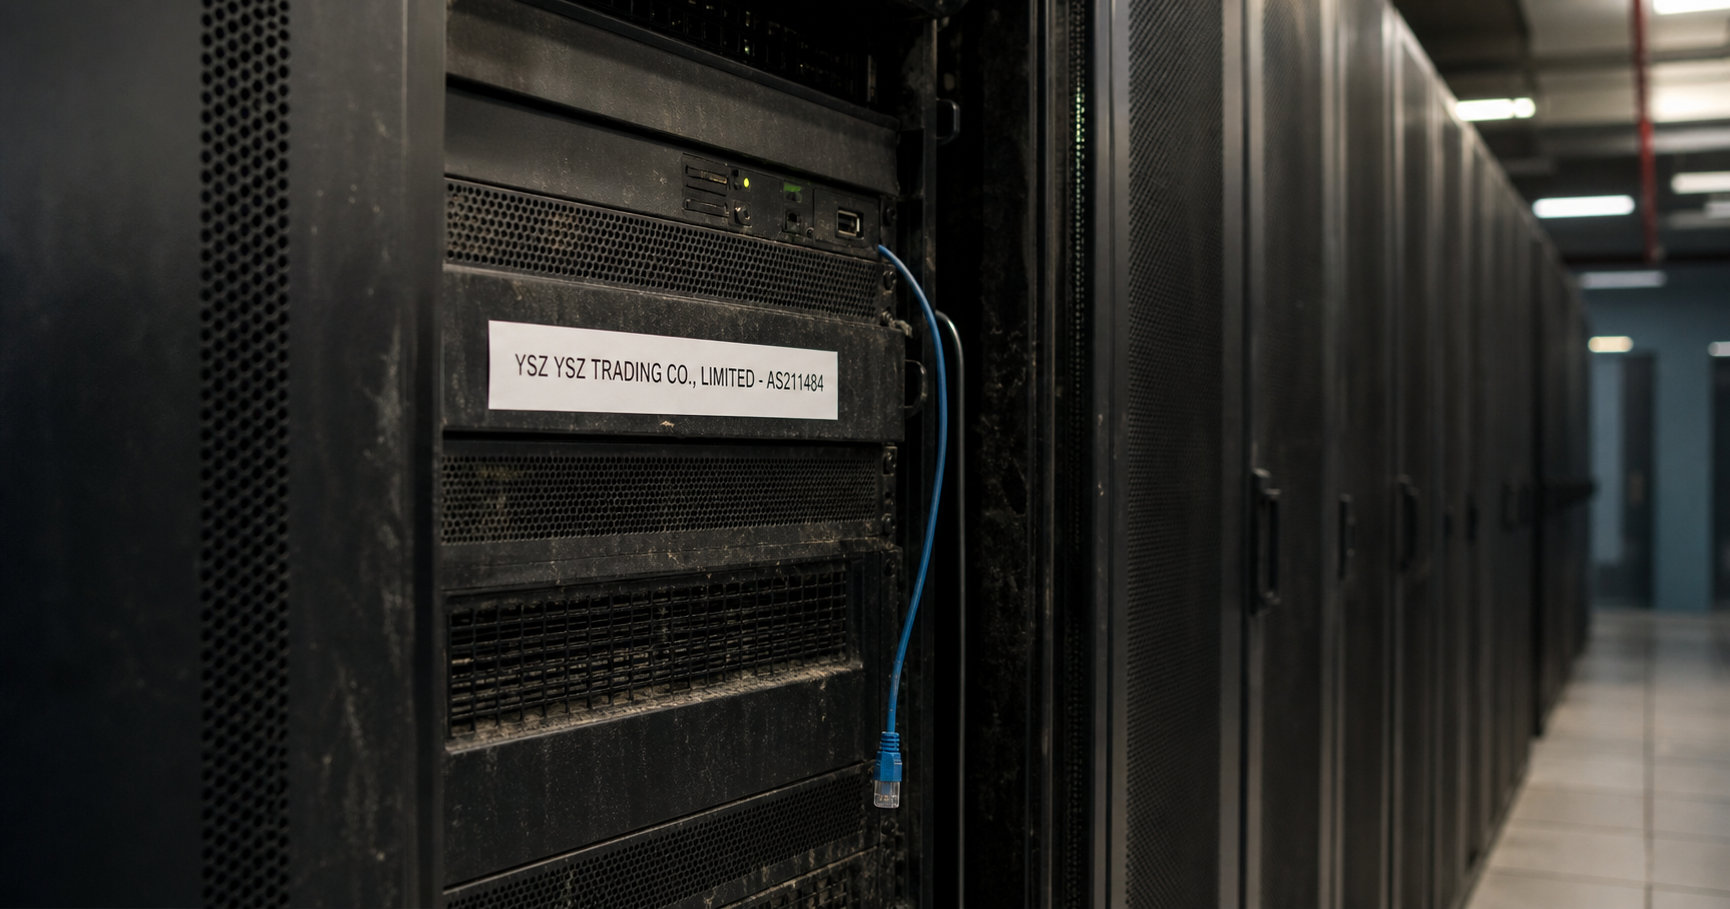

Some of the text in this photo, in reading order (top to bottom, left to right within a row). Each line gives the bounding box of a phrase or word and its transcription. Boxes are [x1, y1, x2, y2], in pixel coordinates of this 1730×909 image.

[515, 353, 549, 377] YSZ
[554, 356, 586, 379] YSZ
[591, 359, 662, 383] TRADING
[666, 363, 697, 388] CO.,
[701, 366, 755, 388] LIMITED
[766, 370, 824, 392] AS211484
